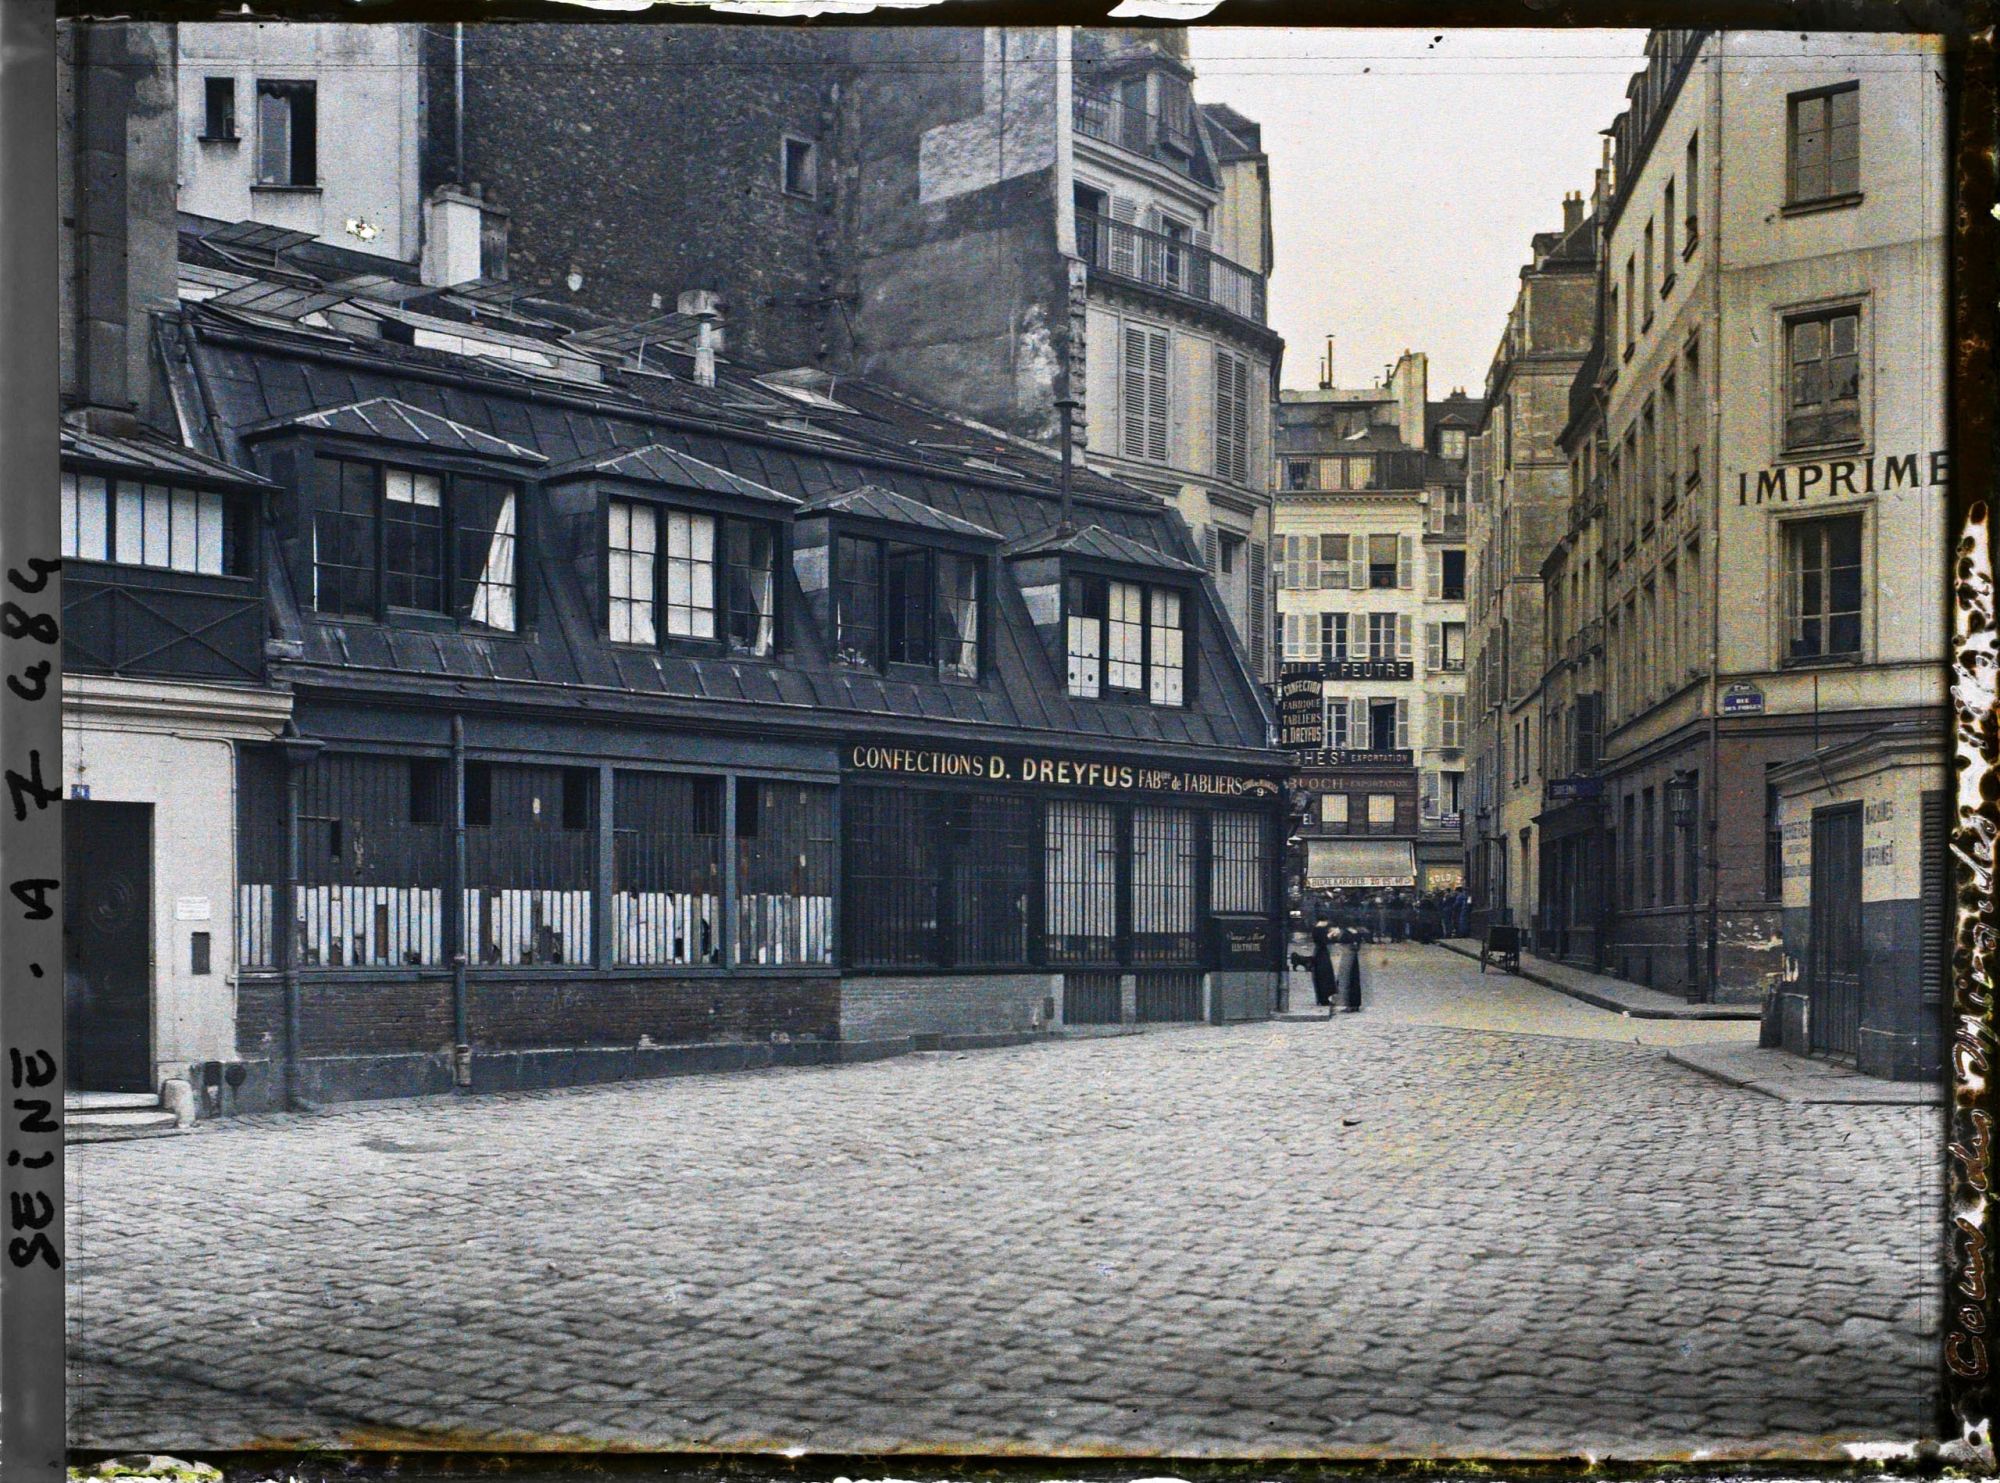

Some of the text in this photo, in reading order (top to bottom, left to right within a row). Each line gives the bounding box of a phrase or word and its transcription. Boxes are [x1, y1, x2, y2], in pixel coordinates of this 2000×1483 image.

[1738, 451, 1950, 506] IMPRIME
[1341, 663, 1408, 677] FEUTRE
[1282, 712, 1322, 725] TABLIERS
[1290, 726, 1322, 743] DREYFUS
[1351, 754, 1408, 763] EXPORTATION
[853, 745, 984, 776] CONFECTIONS
[989, 755, 1011, 779] D.
[1022, 757, 1133, 788] DREYFUS
[1183, 772, 1243, 795] TABLIERS
[1256, 787, 1265, 797] 9
[10, 879, 60, 920] A
